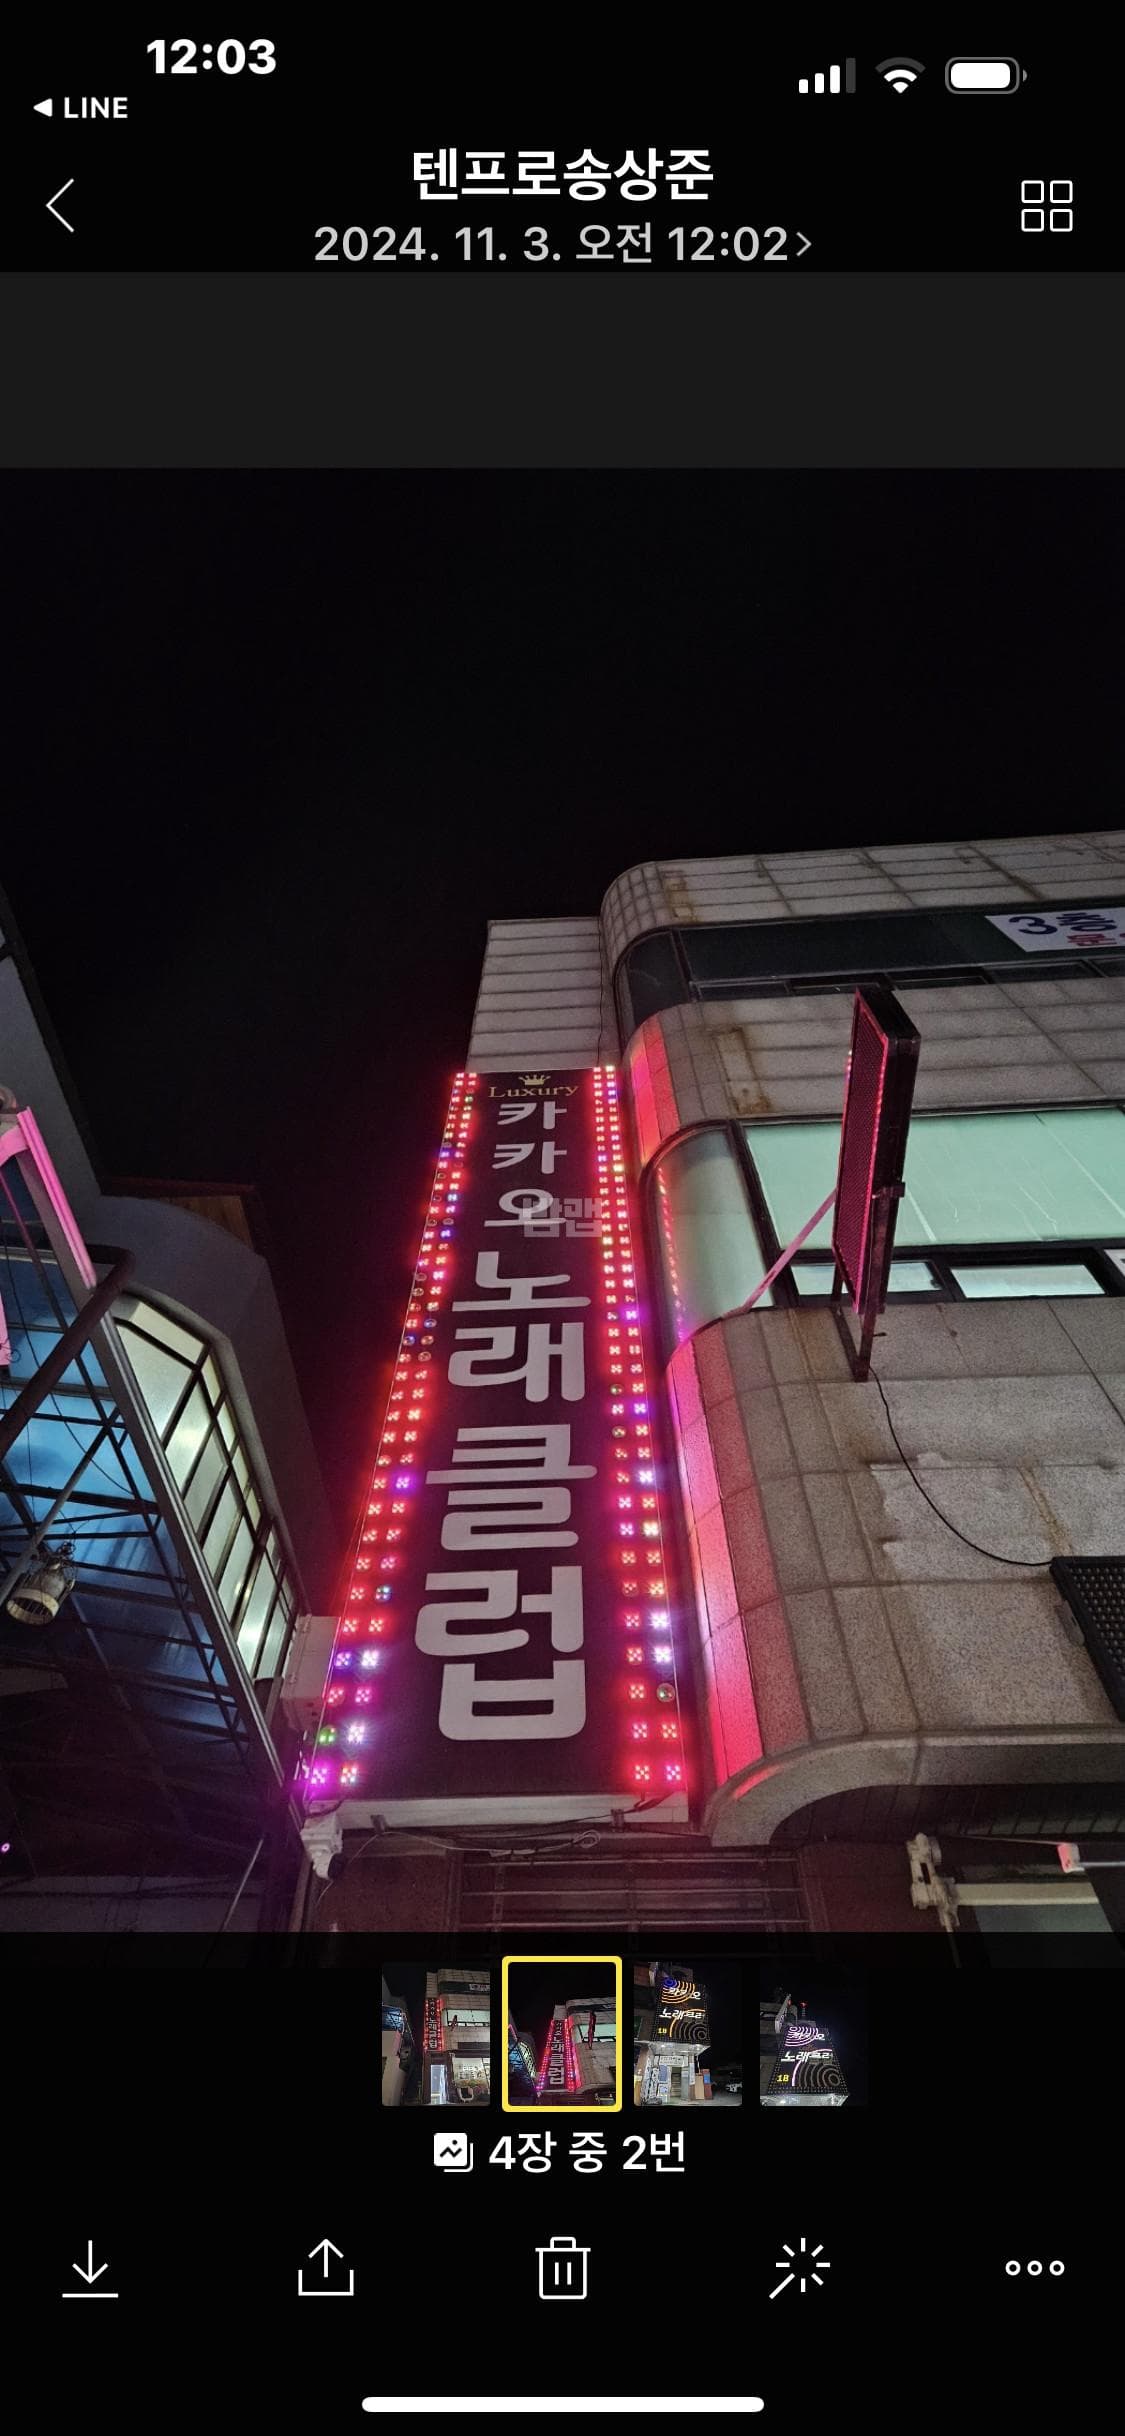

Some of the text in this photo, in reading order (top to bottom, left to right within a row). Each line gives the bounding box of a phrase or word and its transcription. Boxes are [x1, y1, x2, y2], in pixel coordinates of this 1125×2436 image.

[146, 38, 277, 75] 12:03
[63, 96, 128, 119] LINE
[413, 147, 714, 202] 텐프로송상준
[314, 221, 788, 264] 2024. 11. 3. 오전 12:02
[1008, 912, 1118, 935] 3층
[488, 1084, 579, 1098] Luxury
[488, 2130, 685, 2174] 4장 중 2번
